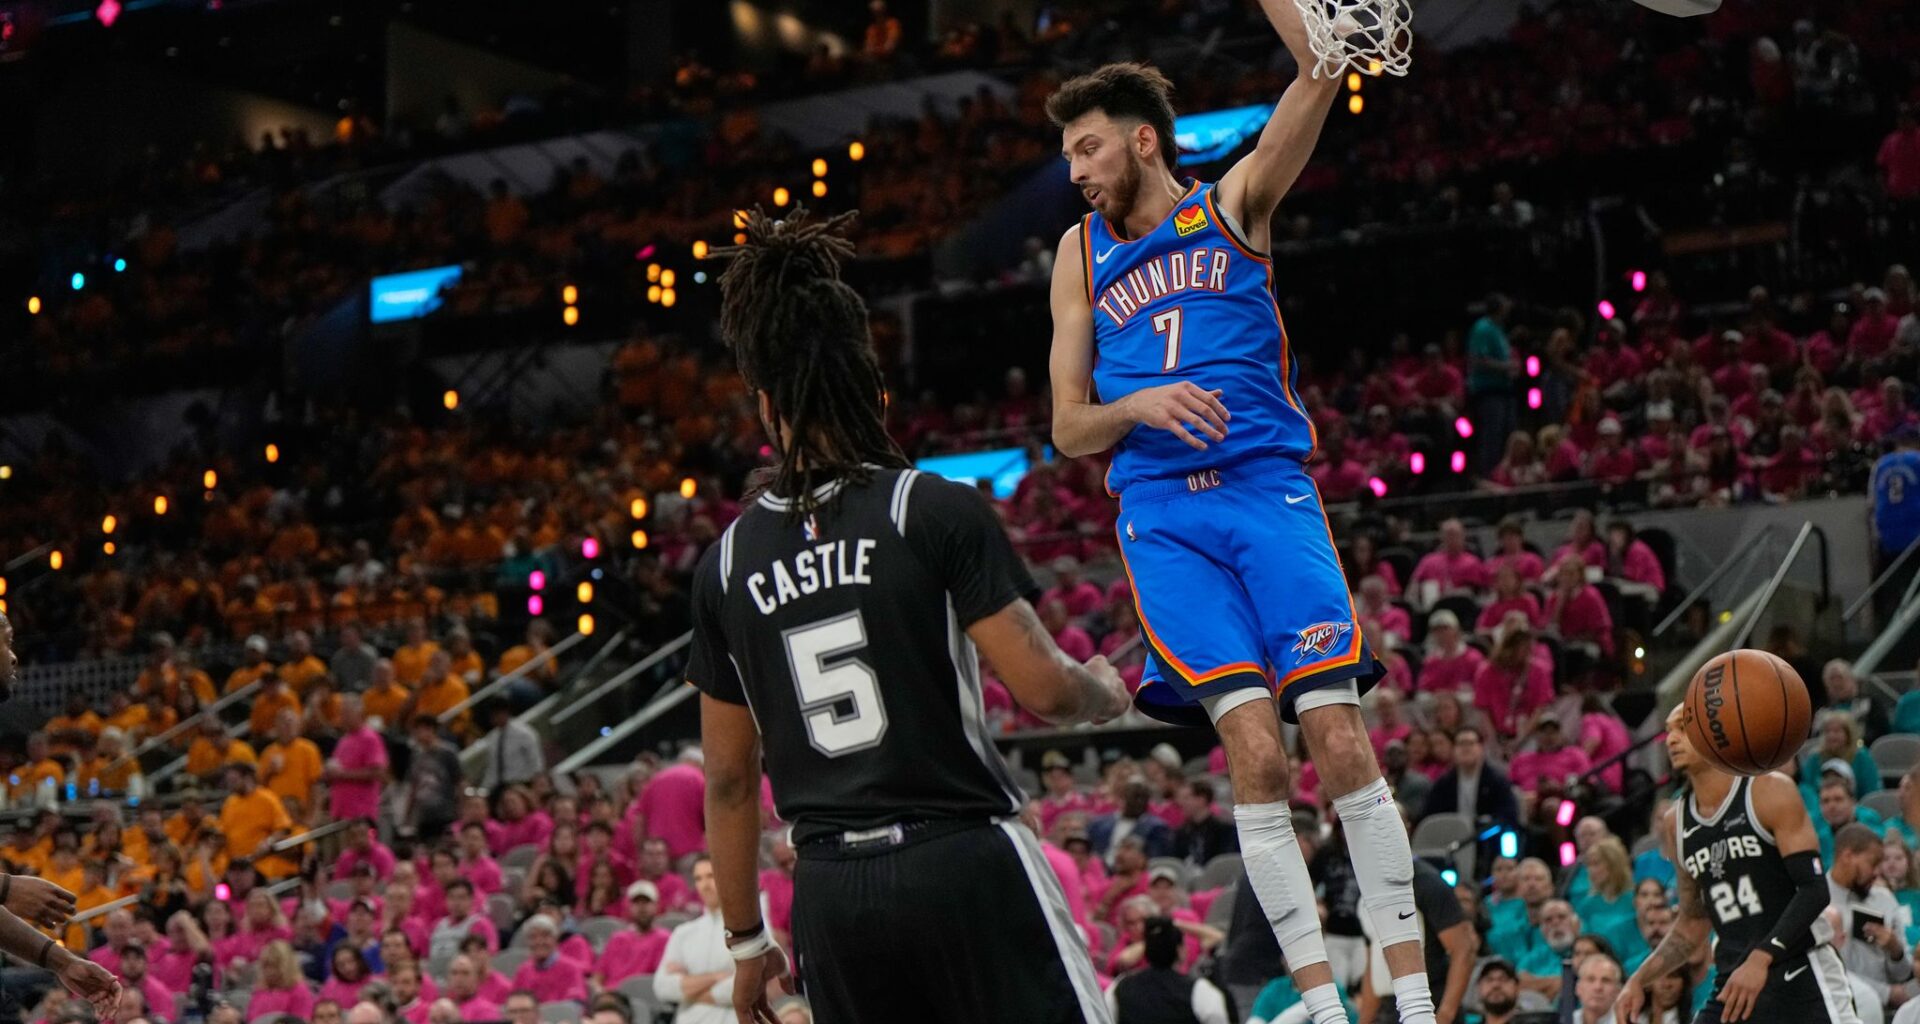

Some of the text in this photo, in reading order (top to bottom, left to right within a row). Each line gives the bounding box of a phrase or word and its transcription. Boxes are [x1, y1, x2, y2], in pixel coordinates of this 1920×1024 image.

[1098, 248, 1229, 328] THUNDER
[1151, 306, 1183, 373] 7
[1187, 469, 1220, 492] OKC
[747, 538, 876, 615] CASTLE
[1303, 625, 1332, 652] OKC
[780, 609, 888, 759] 5
[1704, 664, 1730, 749] Wilson
[1684, 835, 1763, 879] SPURS
[1709, 874, 1763, 924] 24
